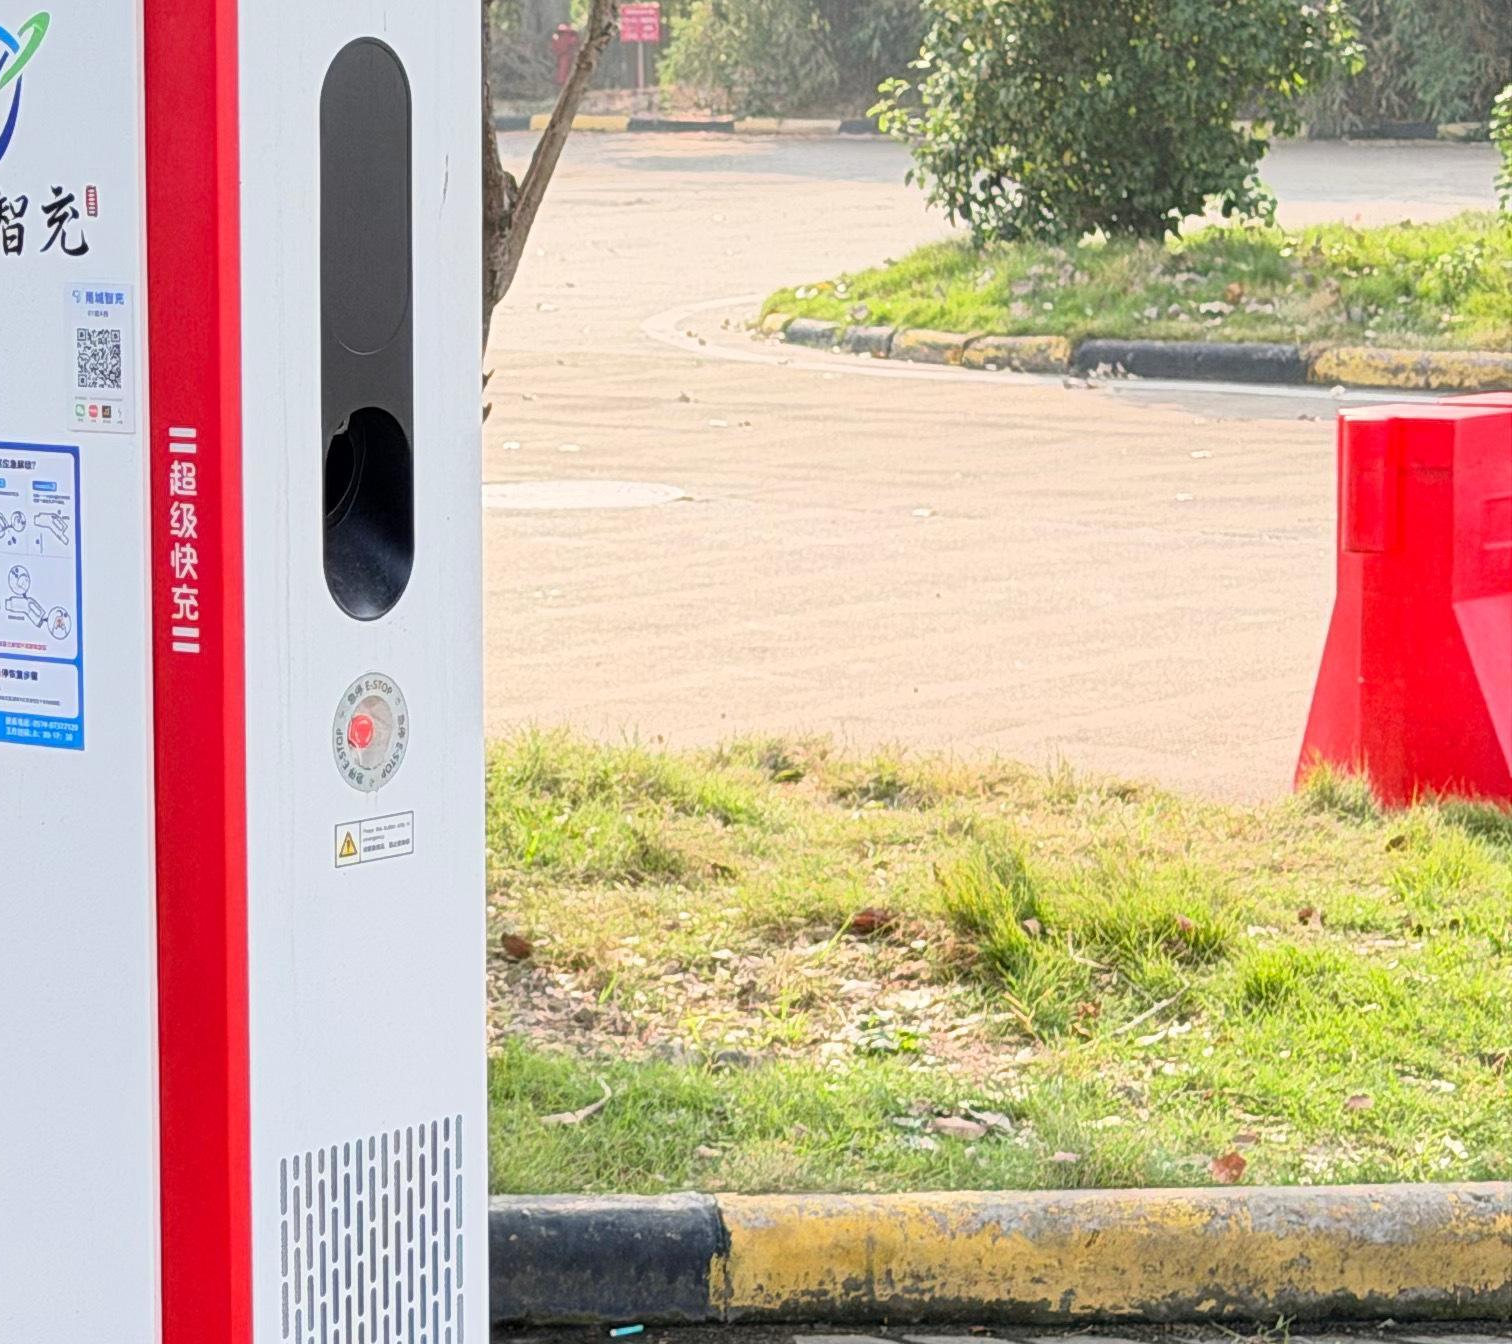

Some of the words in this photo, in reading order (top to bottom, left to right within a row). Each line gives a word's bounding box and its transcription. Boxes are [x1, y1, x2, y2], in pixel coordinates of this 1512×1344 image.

[169, 460, 200, 621] 超级快充
[365, 679, 393, 695] E-STOP
